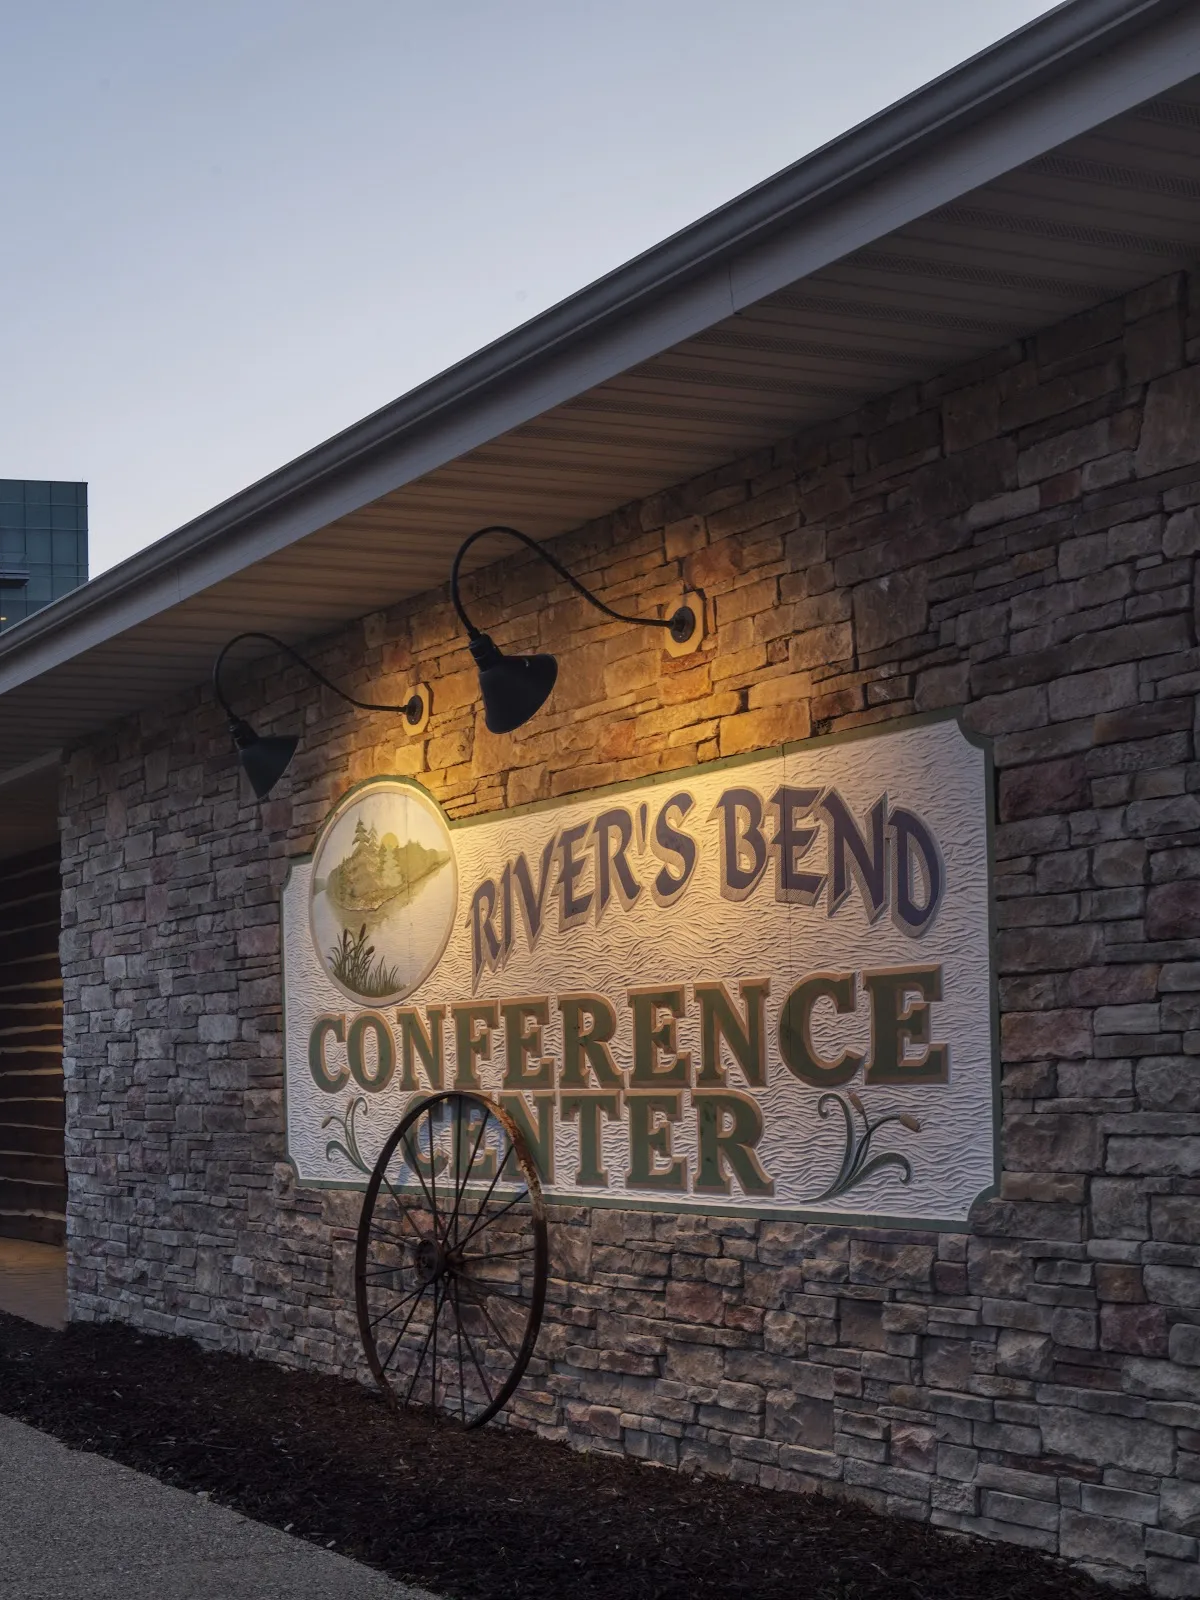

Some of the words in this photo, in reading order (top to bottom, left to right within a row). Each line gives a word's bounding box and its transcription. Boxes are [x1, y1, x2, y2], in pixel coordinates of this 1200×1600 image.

[466, 790, 696, 995] RIVER'S
[707, 785, 945, 937] BEND
[309, 964, 949, 1093] CONFERENCE
[402, 1089, 775, 1196] CENTER
